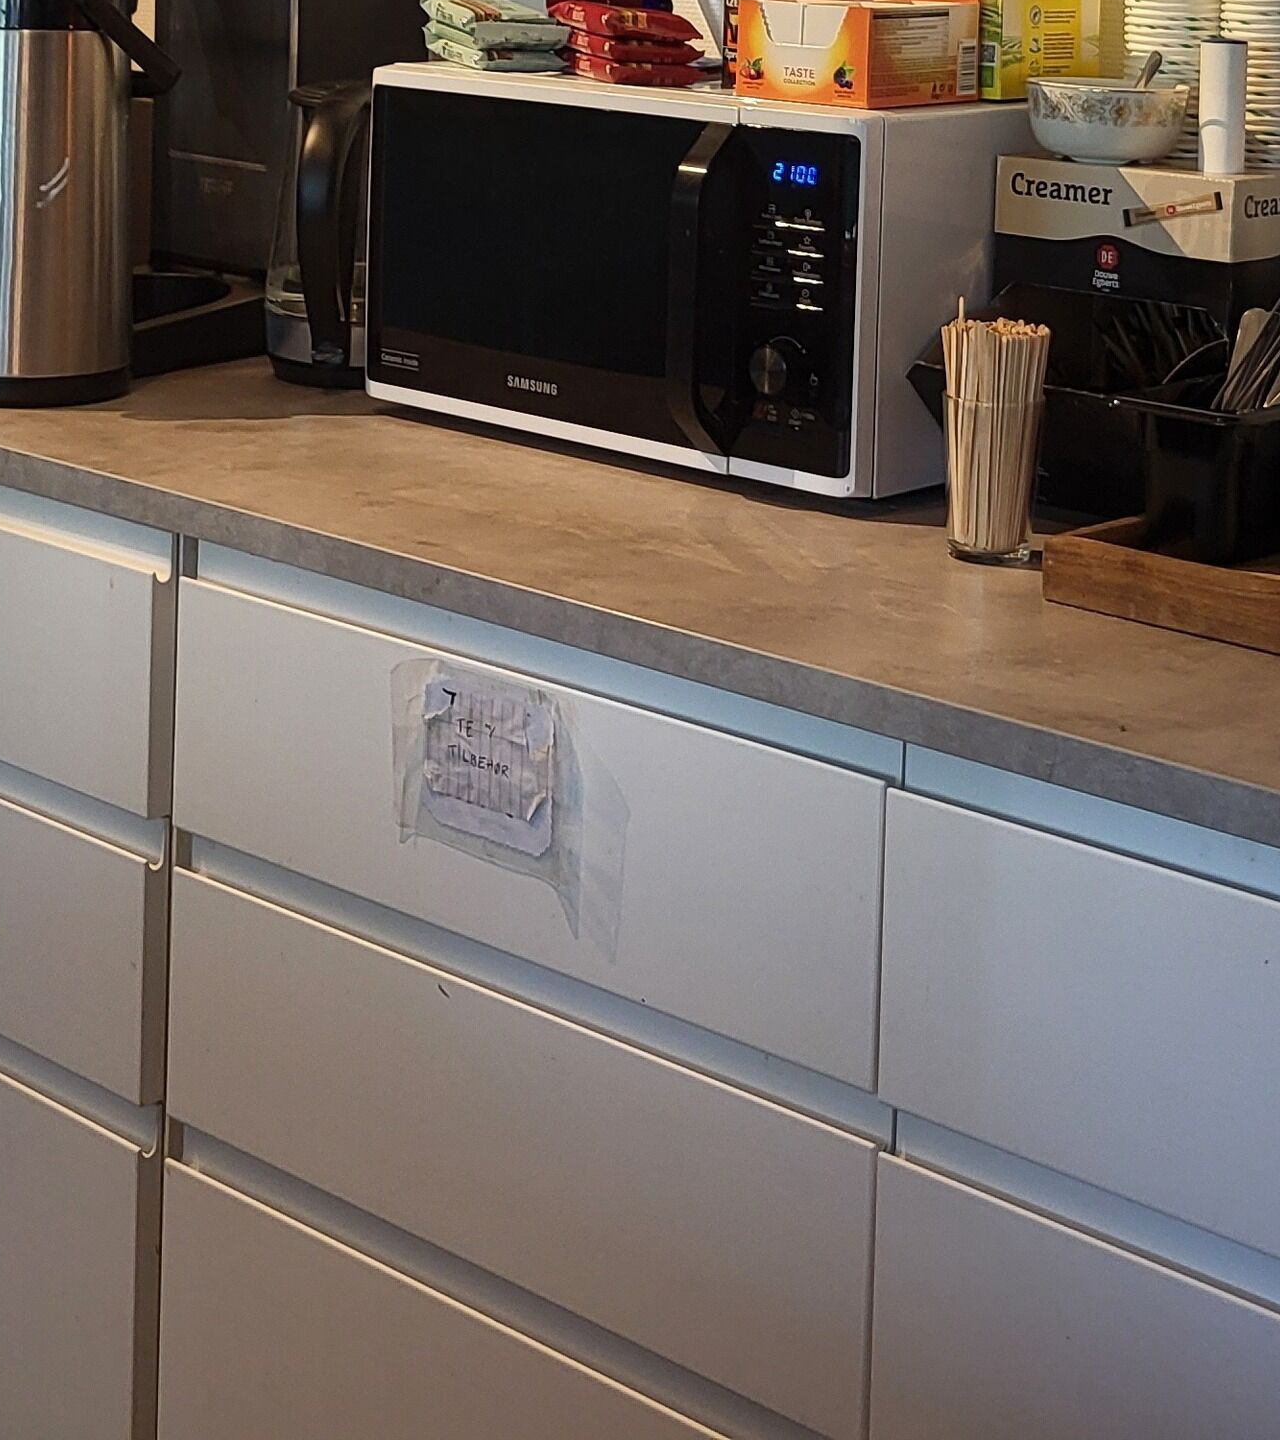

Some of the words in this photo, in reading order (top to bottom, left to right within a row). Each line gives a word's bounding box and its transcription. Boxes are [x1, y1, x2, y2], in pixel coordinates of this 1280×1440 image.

[783, 66, 816, 80] TASTE
[783, 78, 817, 87] COLLECTION
[1011, 171, 1113, 206] Creamer
[1100, 249, 1114, 263] DE
[506, 374, 559, 396] SAMSUNG
